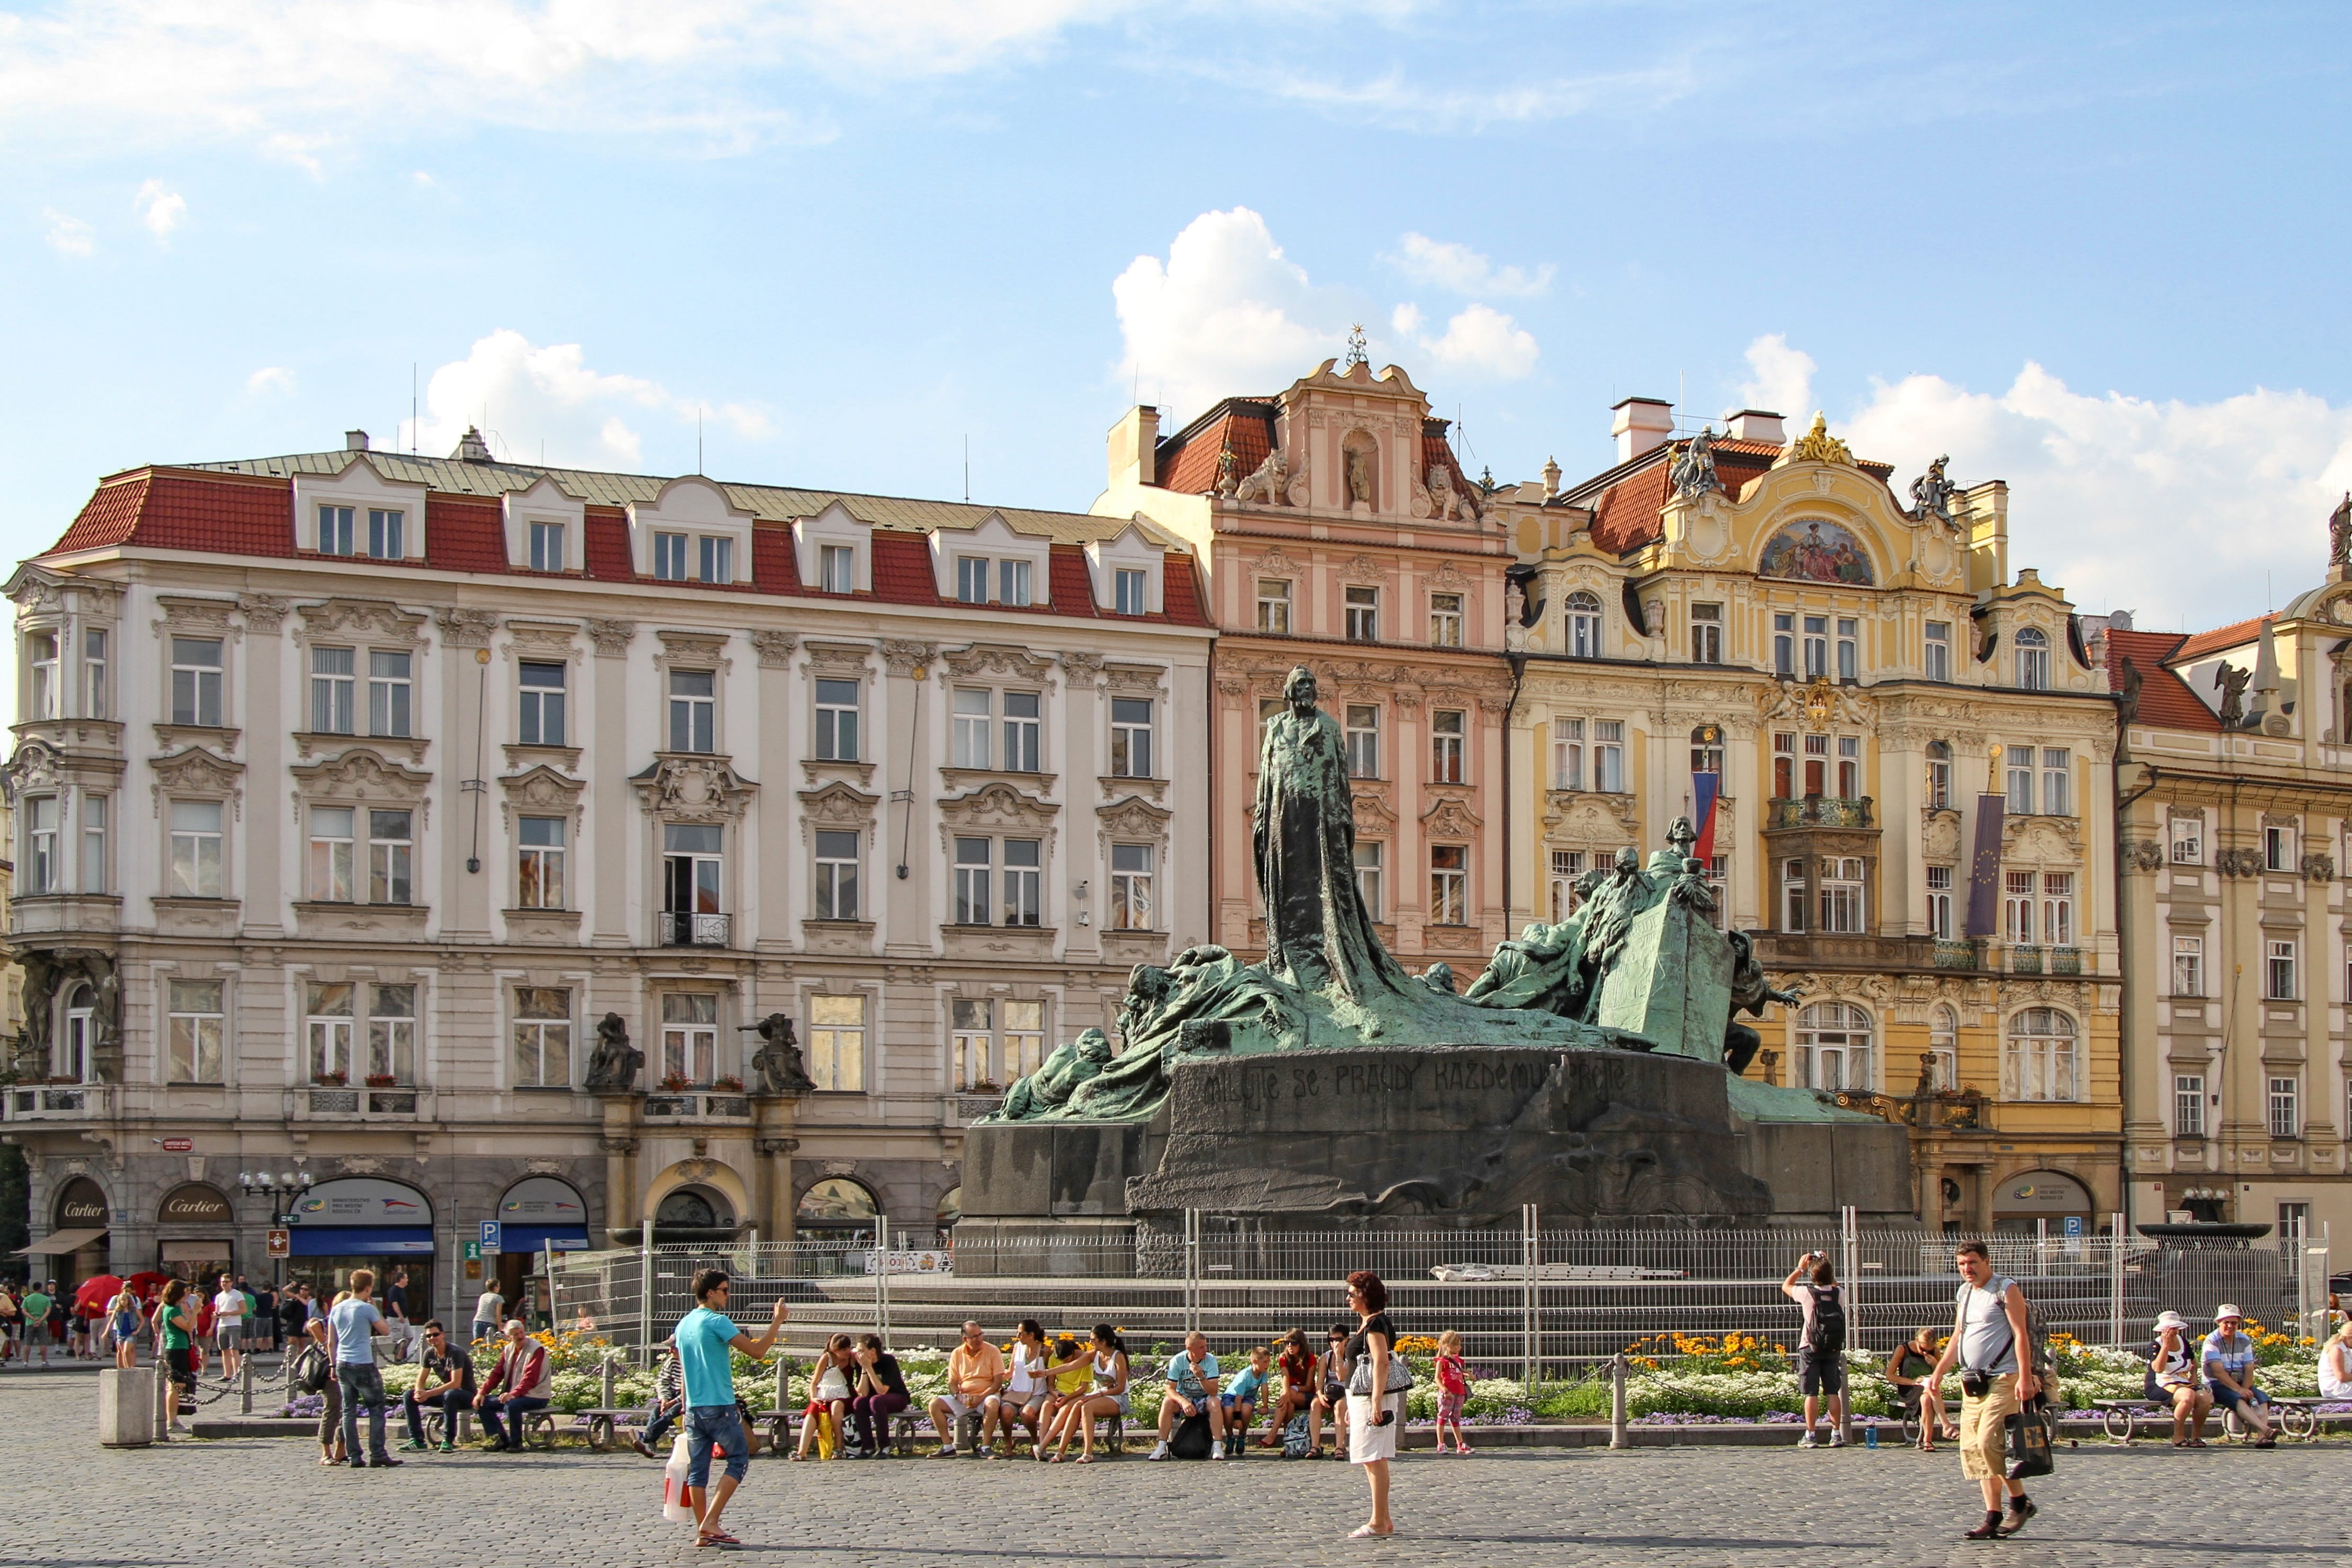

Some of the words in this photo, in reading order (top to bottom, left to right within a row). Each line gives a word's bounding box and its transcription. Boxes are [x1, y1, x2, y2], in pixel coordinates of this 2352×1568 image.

[65, 1201, 104, 1217] Cartier
[169, 1199, 223, 1212] Cartier
[484, 1224, 496, 1240] P
